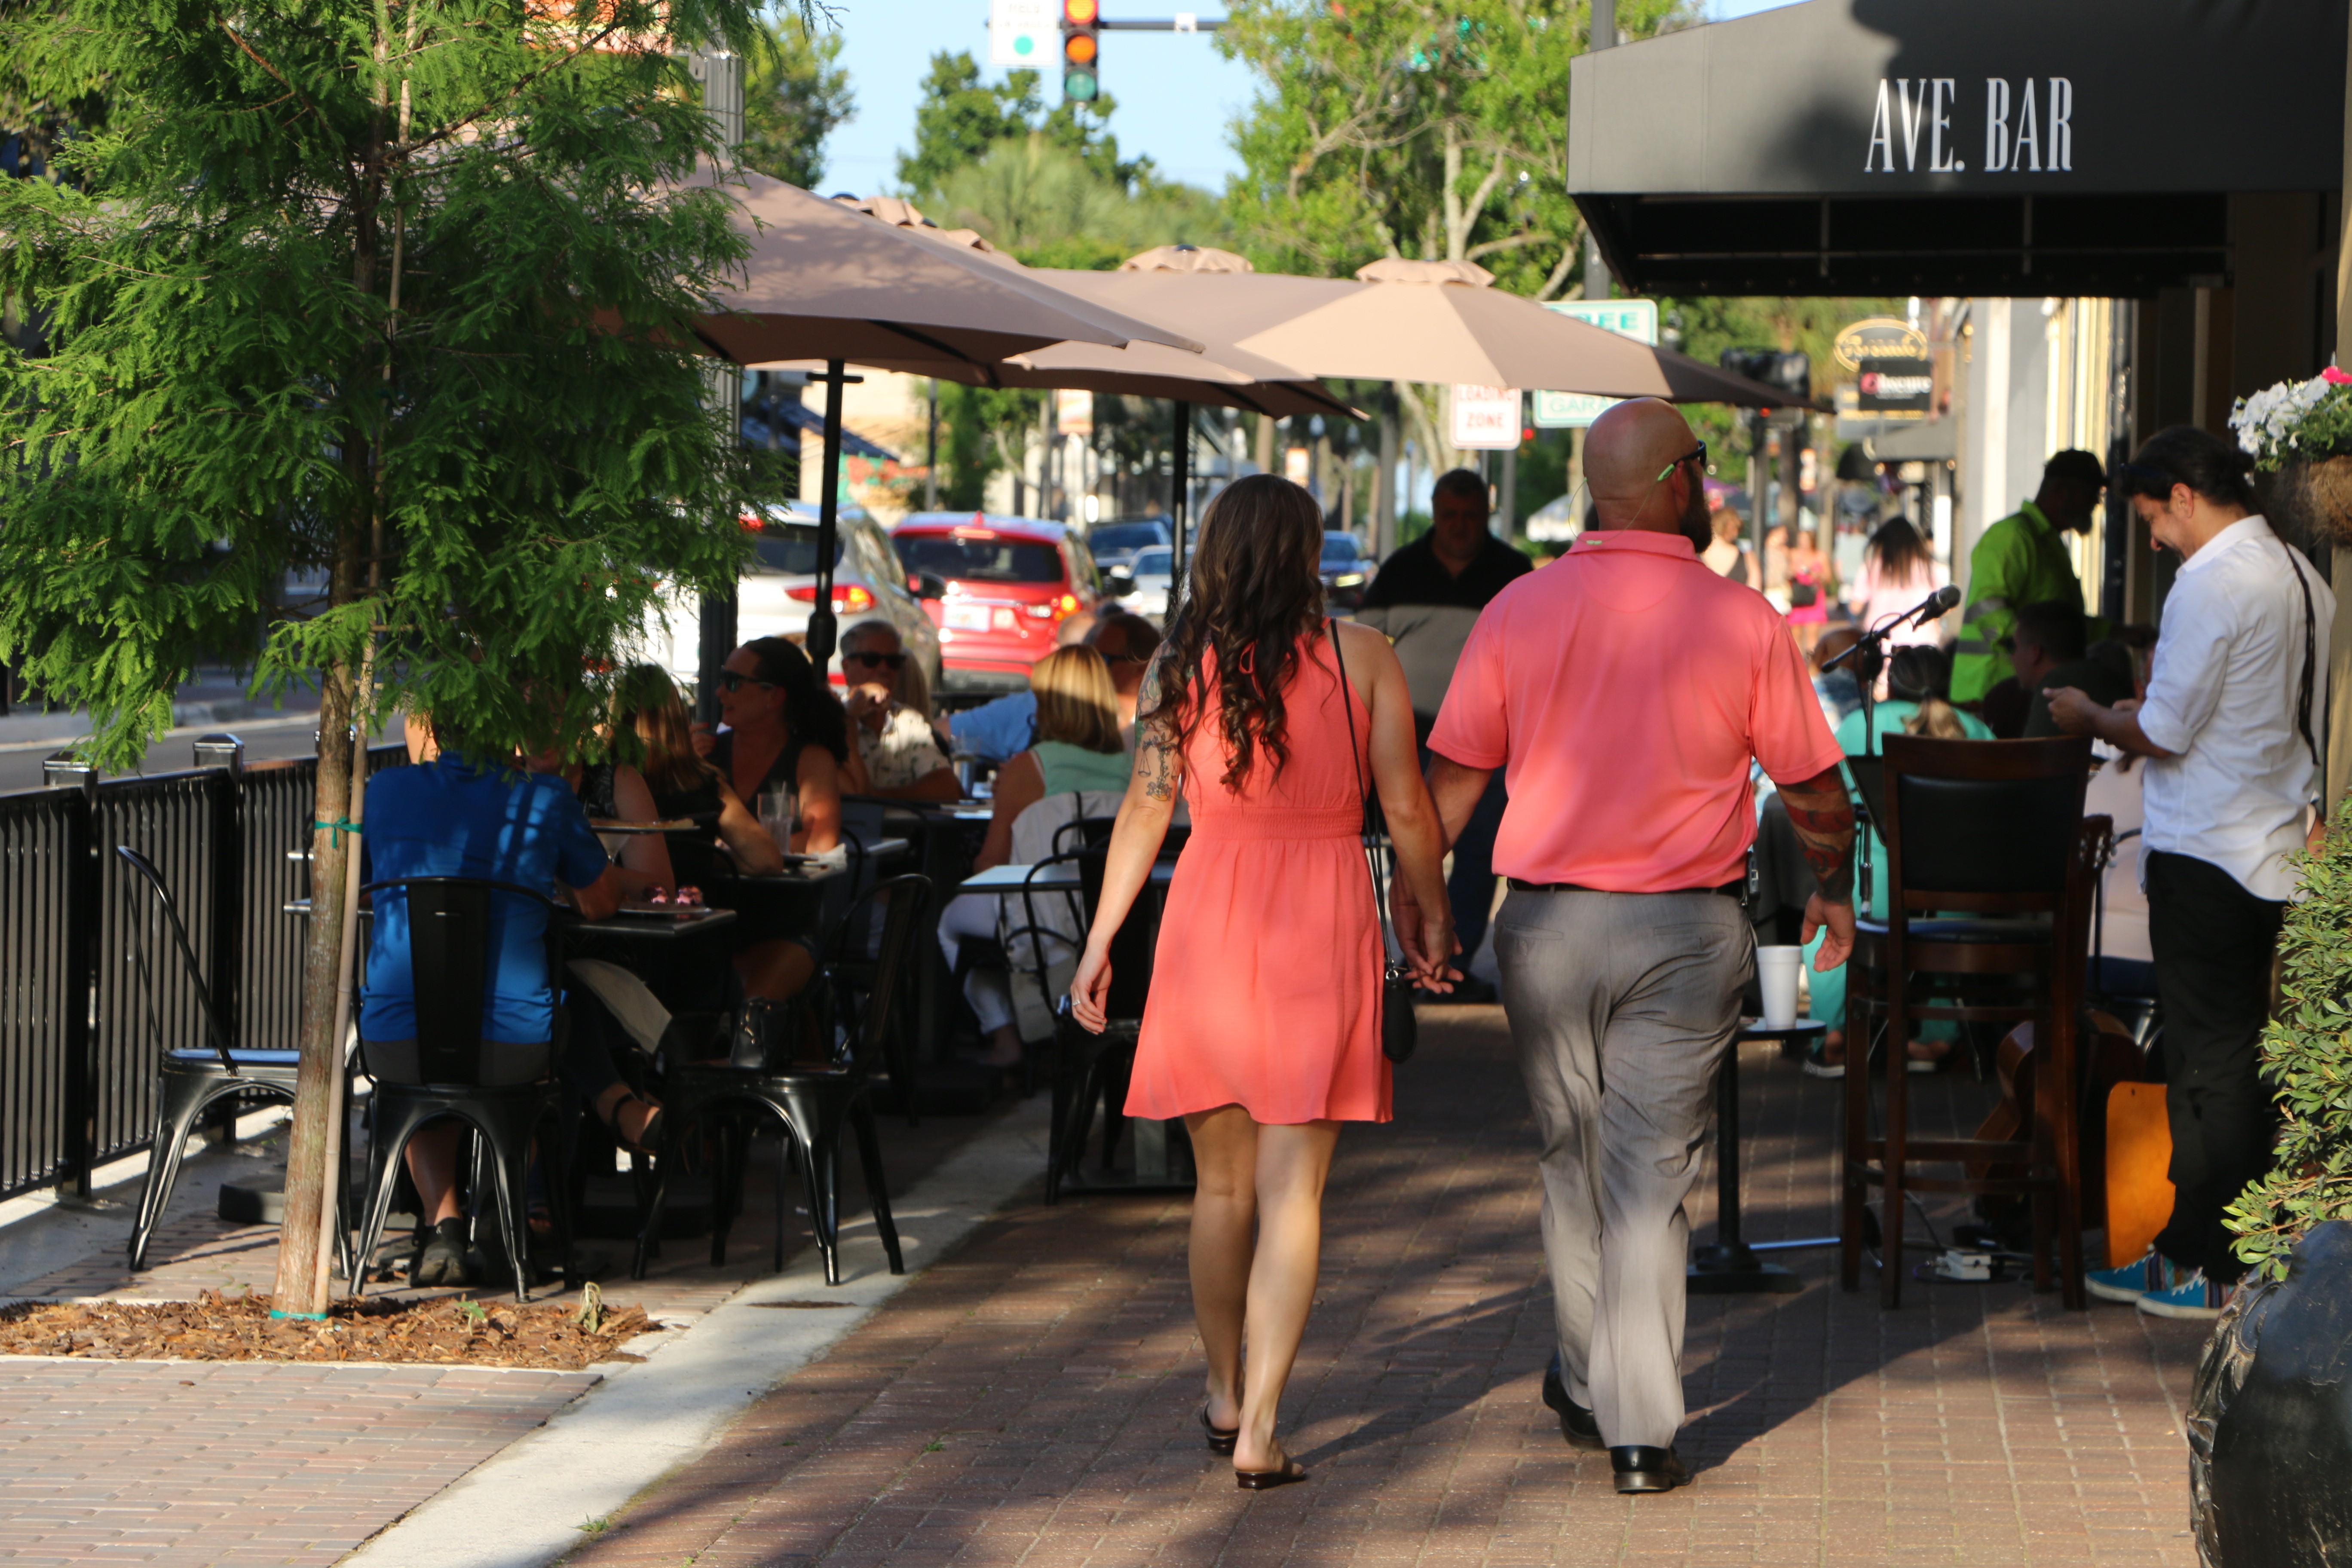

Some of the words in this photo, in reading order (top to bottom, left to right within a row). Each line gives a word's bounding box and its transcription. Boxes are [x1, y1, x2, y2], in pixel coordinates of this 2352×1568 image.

[1864, 78, 1966, 172] AVE.
[1984, 77, 2073, 172] BAR
[1466, 412, 1504, 427] ZONE
